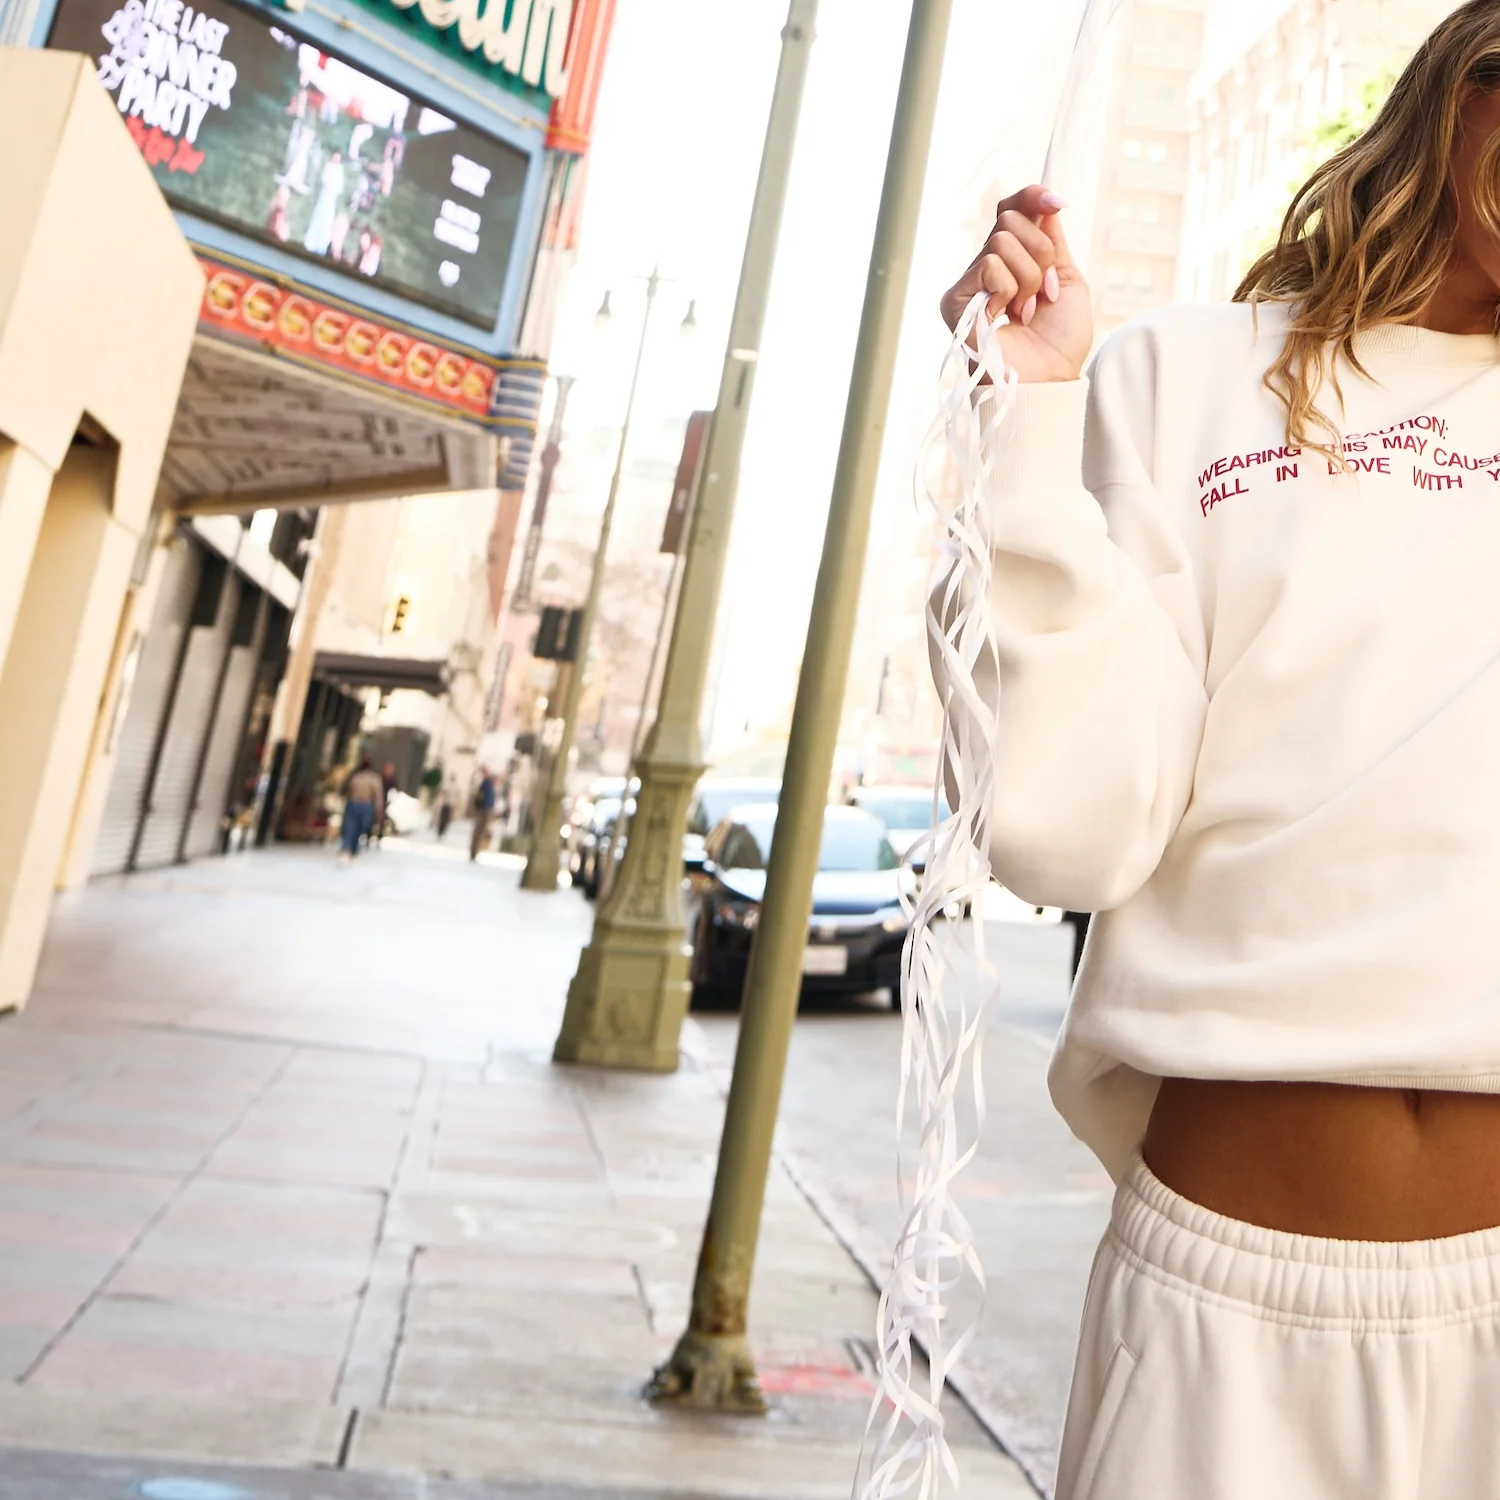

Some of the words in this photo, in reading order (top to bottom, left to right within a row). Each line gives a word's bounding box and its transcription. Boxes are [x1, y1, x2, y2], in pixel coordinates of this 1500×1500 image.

[117, 67, 209, 143] PARTY
[1198, 446, 1301, 488] WEARING
[1382, 435, 1428, 456] MAY
[1200, 478, 1249, 517] FALL
[1276, 463, 1298, 482] IN
[1328, 457, 1391, 475] LOVE
[1413, 465, 1463, 490] WITH
